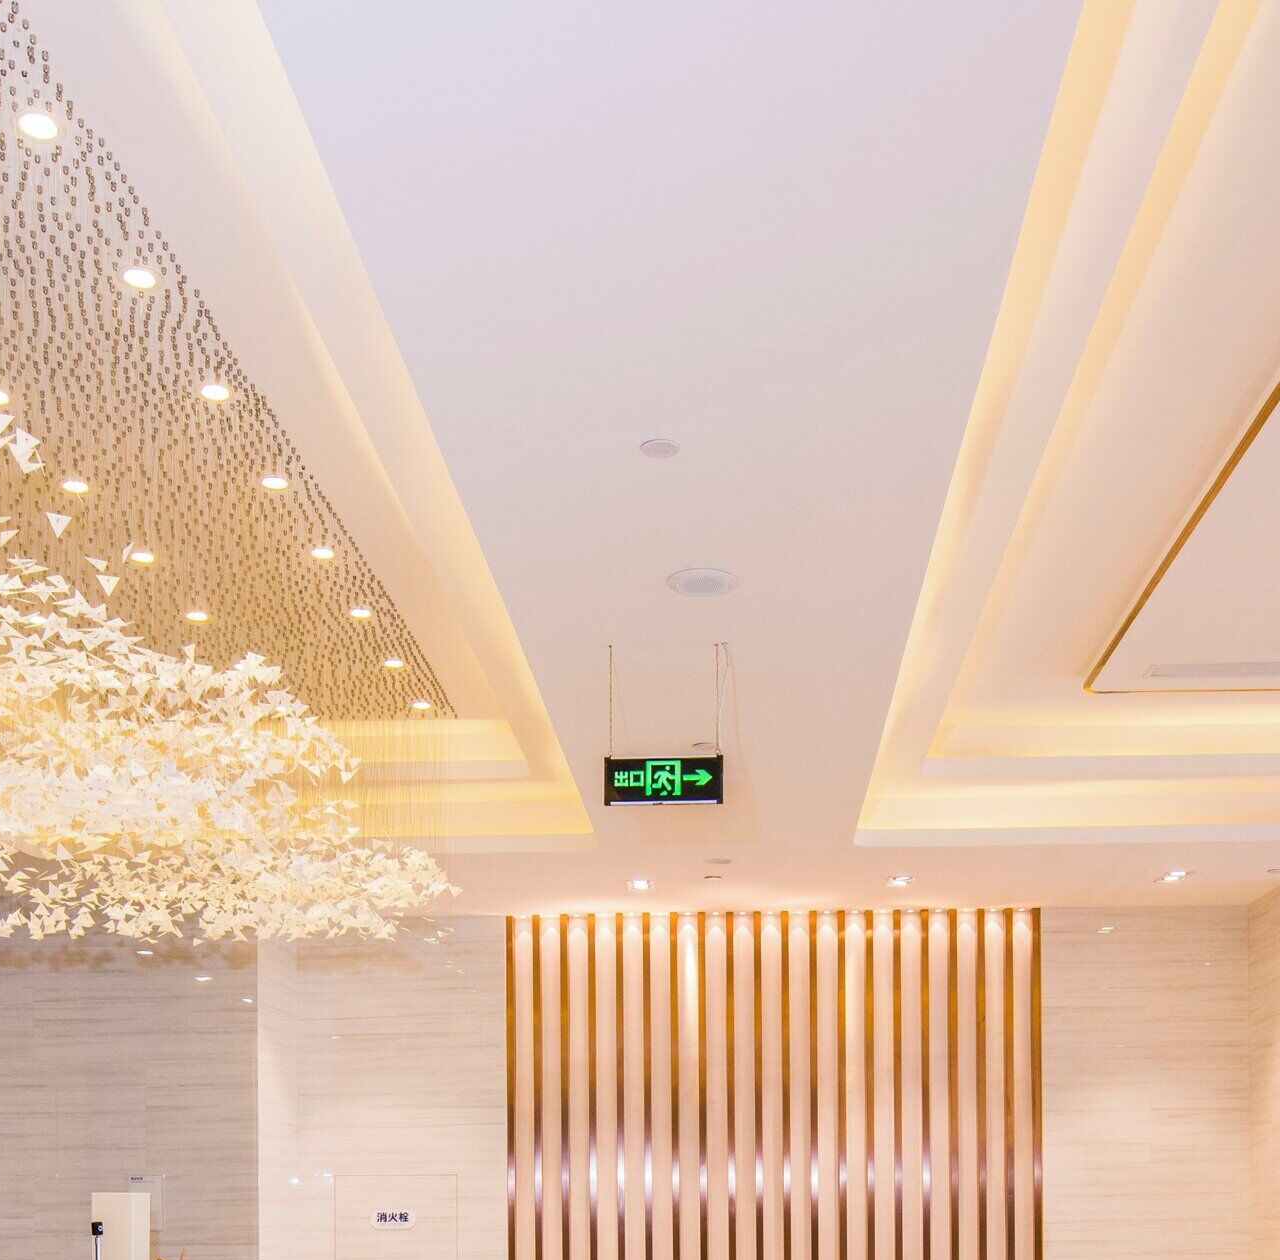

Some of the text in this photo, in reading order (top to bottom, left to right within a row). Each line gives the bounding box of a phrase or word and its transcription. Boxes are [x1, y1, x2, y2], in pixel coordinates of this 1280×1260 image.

[614, 770, 645, 787] 出口
[376, 1212, 409, 1223] 消火栓
